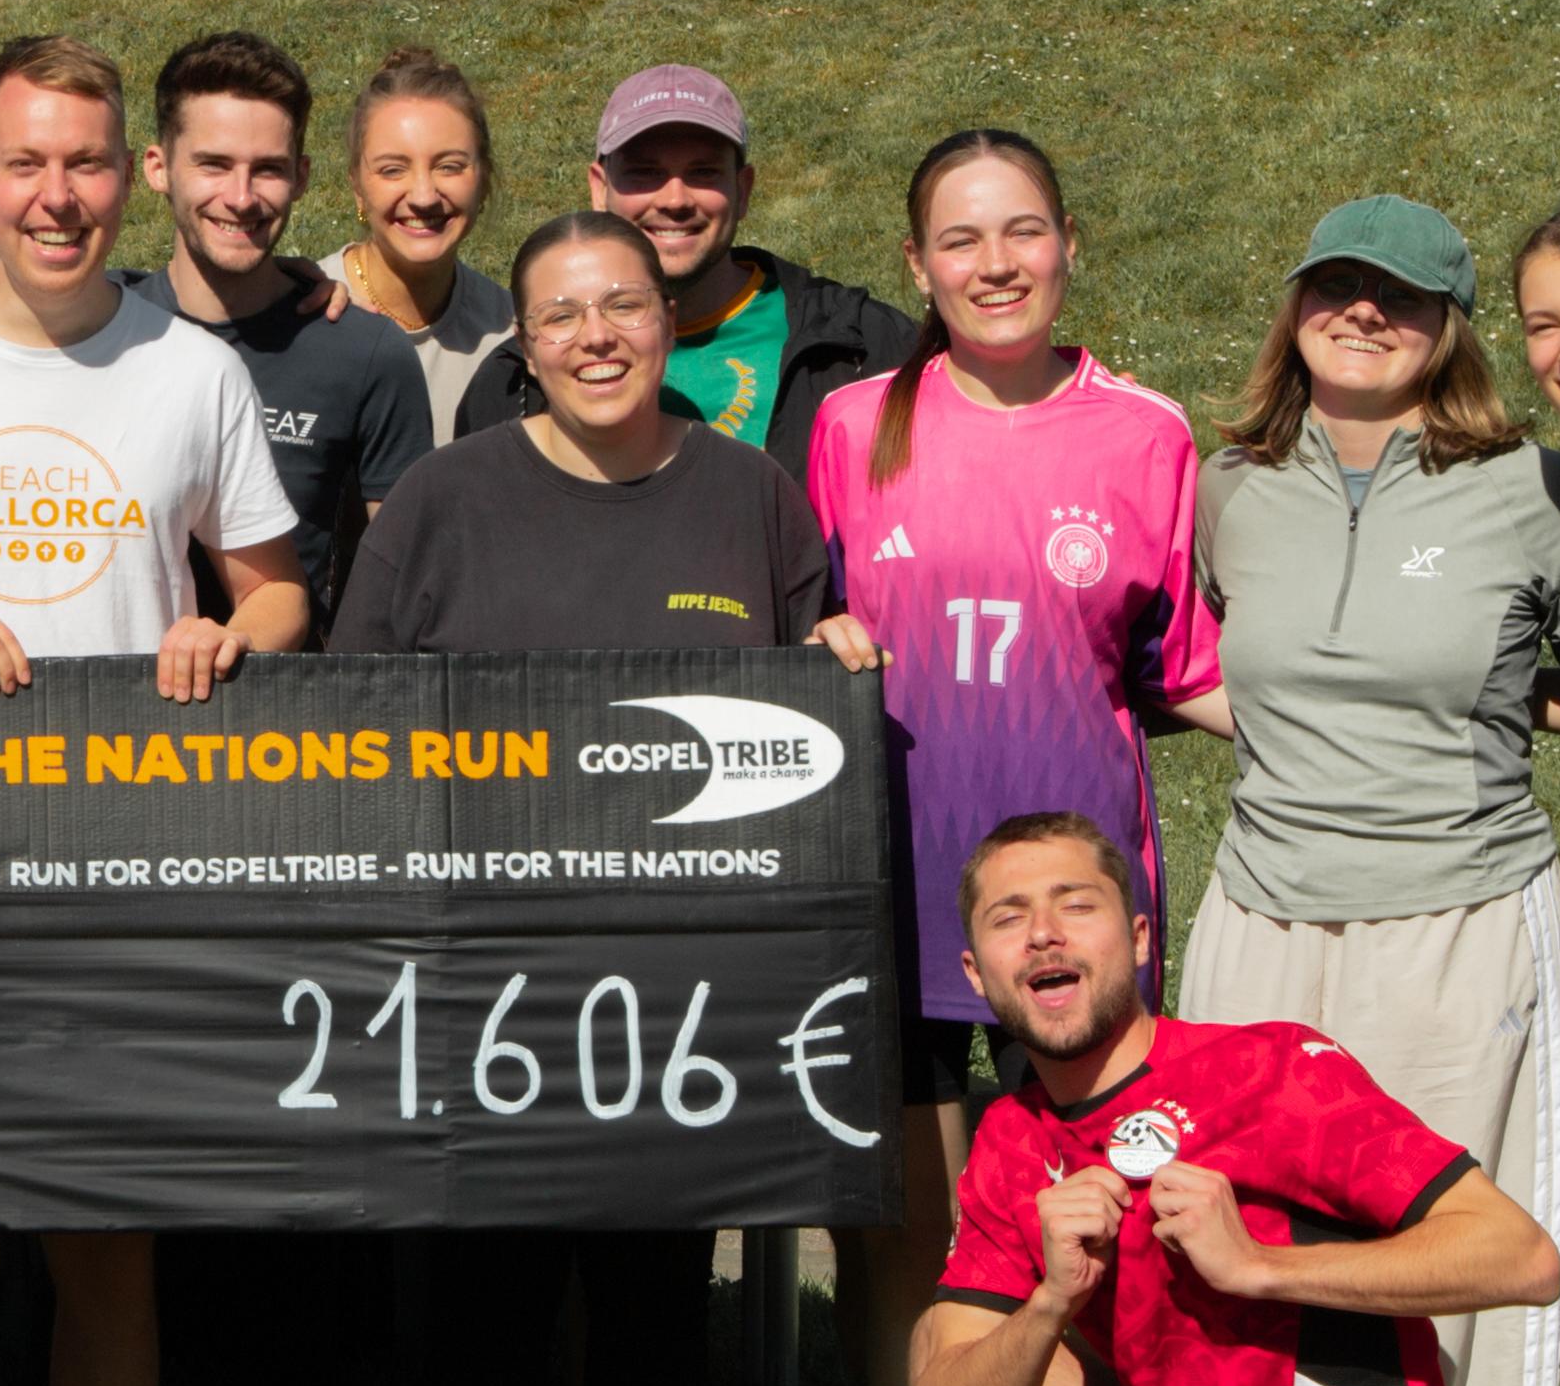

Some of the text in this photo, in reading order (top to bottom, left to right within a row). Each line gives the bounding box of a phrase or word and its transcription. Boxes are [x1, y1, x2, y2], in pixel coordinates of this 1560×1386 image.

[263, 407, 319, 438] EA7
[667, 594, 707, 610] HYPE
[945, 598, 1023, 687] 17
[85, 730, 391, 784] NATIONS
[410, 730, 549, 780] RUN
[578, 738, 811, 774] GOSPEL TRIBE
[723, 766, 815, 781] make a change
[10, 860, 78, 888] RUN
[86, 858, 151, 887] FOR
[158, 854, 379, 887] GOSPELTRIBE
[406, 852, 477, 880] RUN
[485, 851, 553, 880] FOR
[558, 850, 626, 878] THE
[631, 849, 781, 878] NATIONS
[278, 961, 883, 1149] 21.606 €
